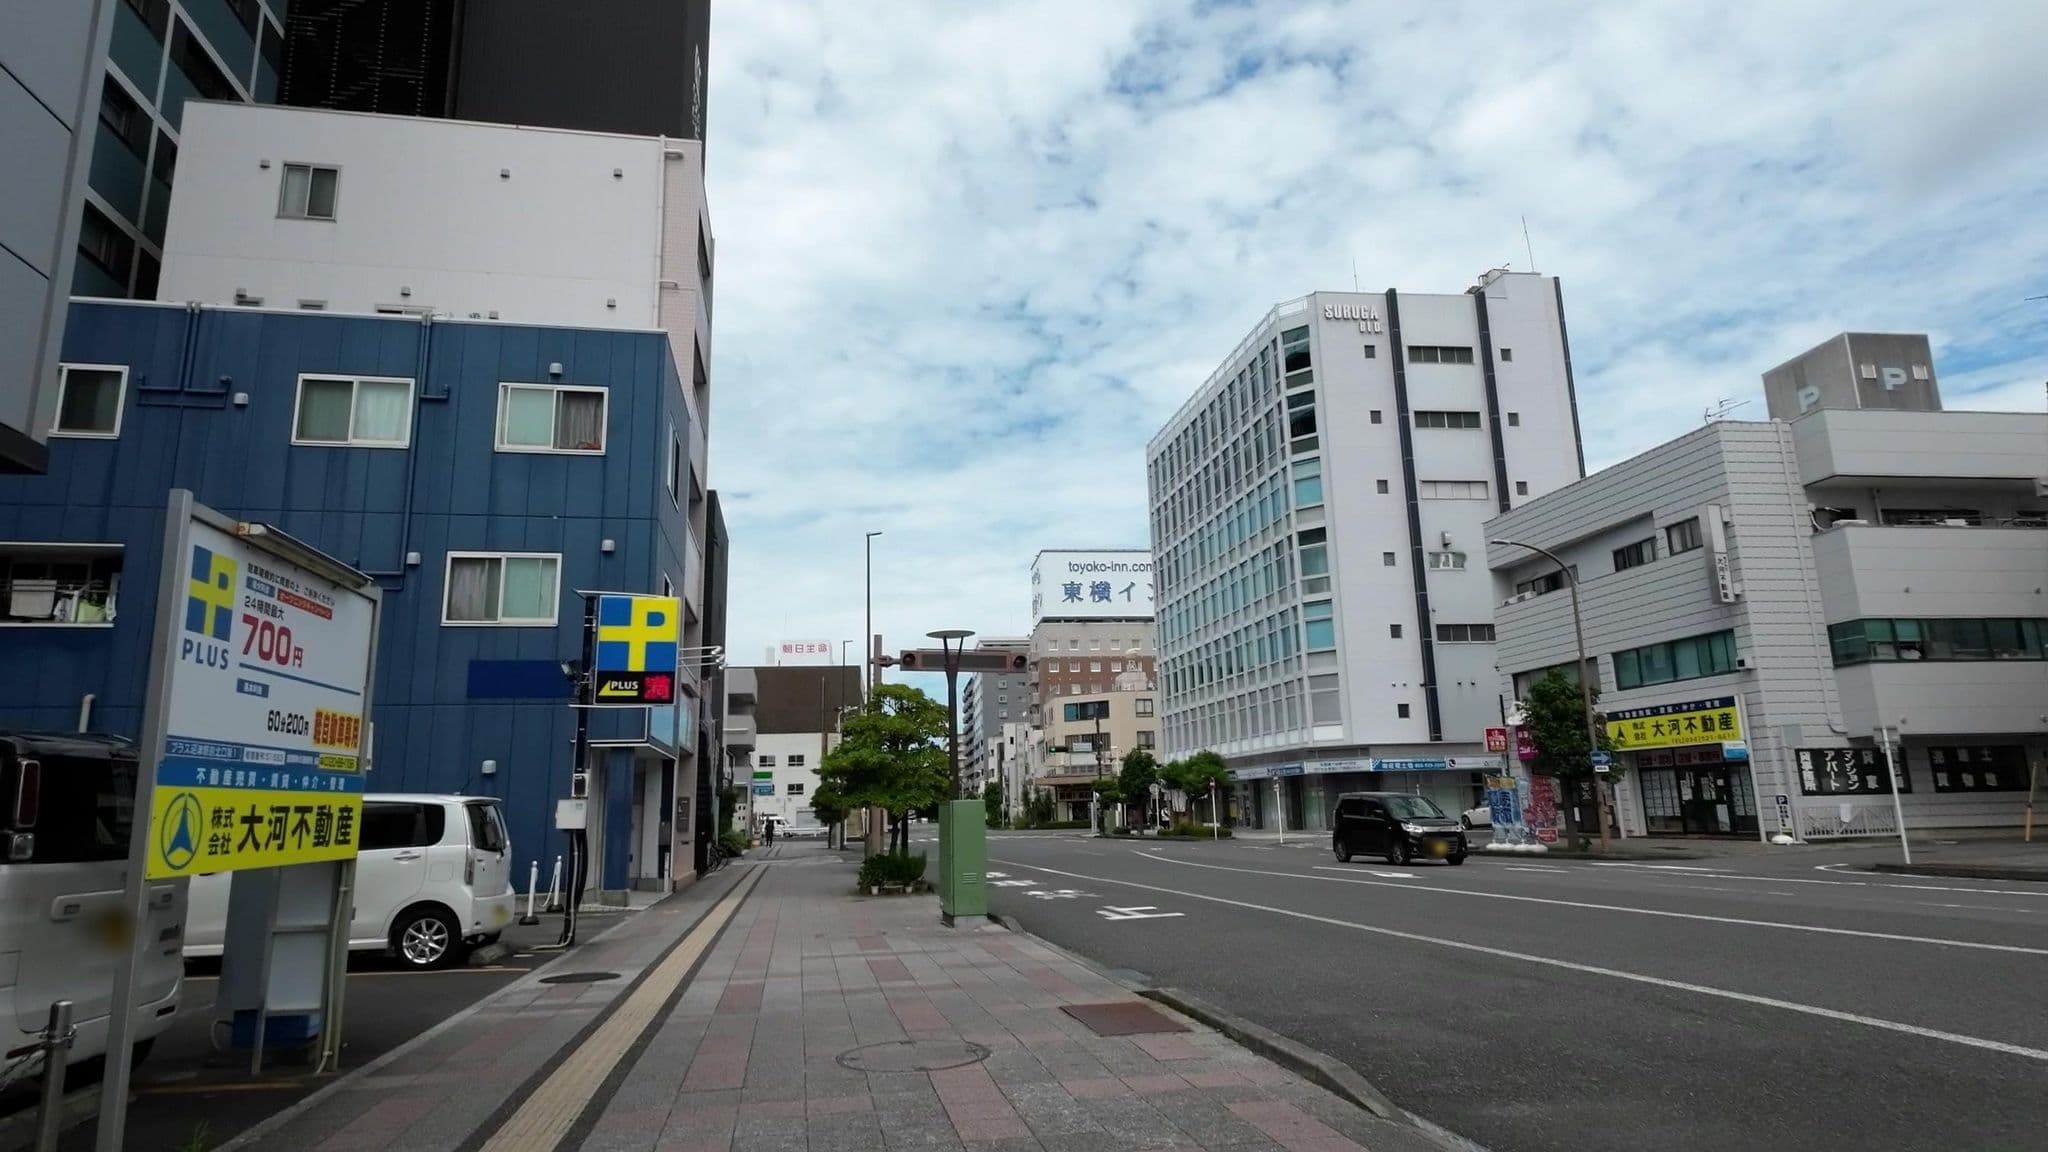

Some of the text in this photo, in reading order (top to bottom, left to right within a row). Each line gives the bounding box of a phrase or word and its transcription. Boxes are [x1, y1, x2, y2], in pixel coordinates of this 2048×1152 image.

[1324, 304, 1379, 321] SURUGA
[1881, 366, 1908, 391] P
[1797, 385, 1821, 414] P
[244, 595, 285, 621] 24時間最大
[182, 637, 230, 670] PLUS
[242, 612, 304, 669] 700円
[782, 643, 829, 654] 朝日生命
[611, 680, 639, 690] PLUS
[267, 709, 310, 737] 60分200円
[1652, 712, 1734, 738] 大河不動産
[1823, 750, 1841, 791] アパート
[1841, 750, 1860, 790] マンション
[210, 806, 235, 830] 株式
[236, 803, 356, 854] 大河不動産
[207, 831, 232, 856] 会社
